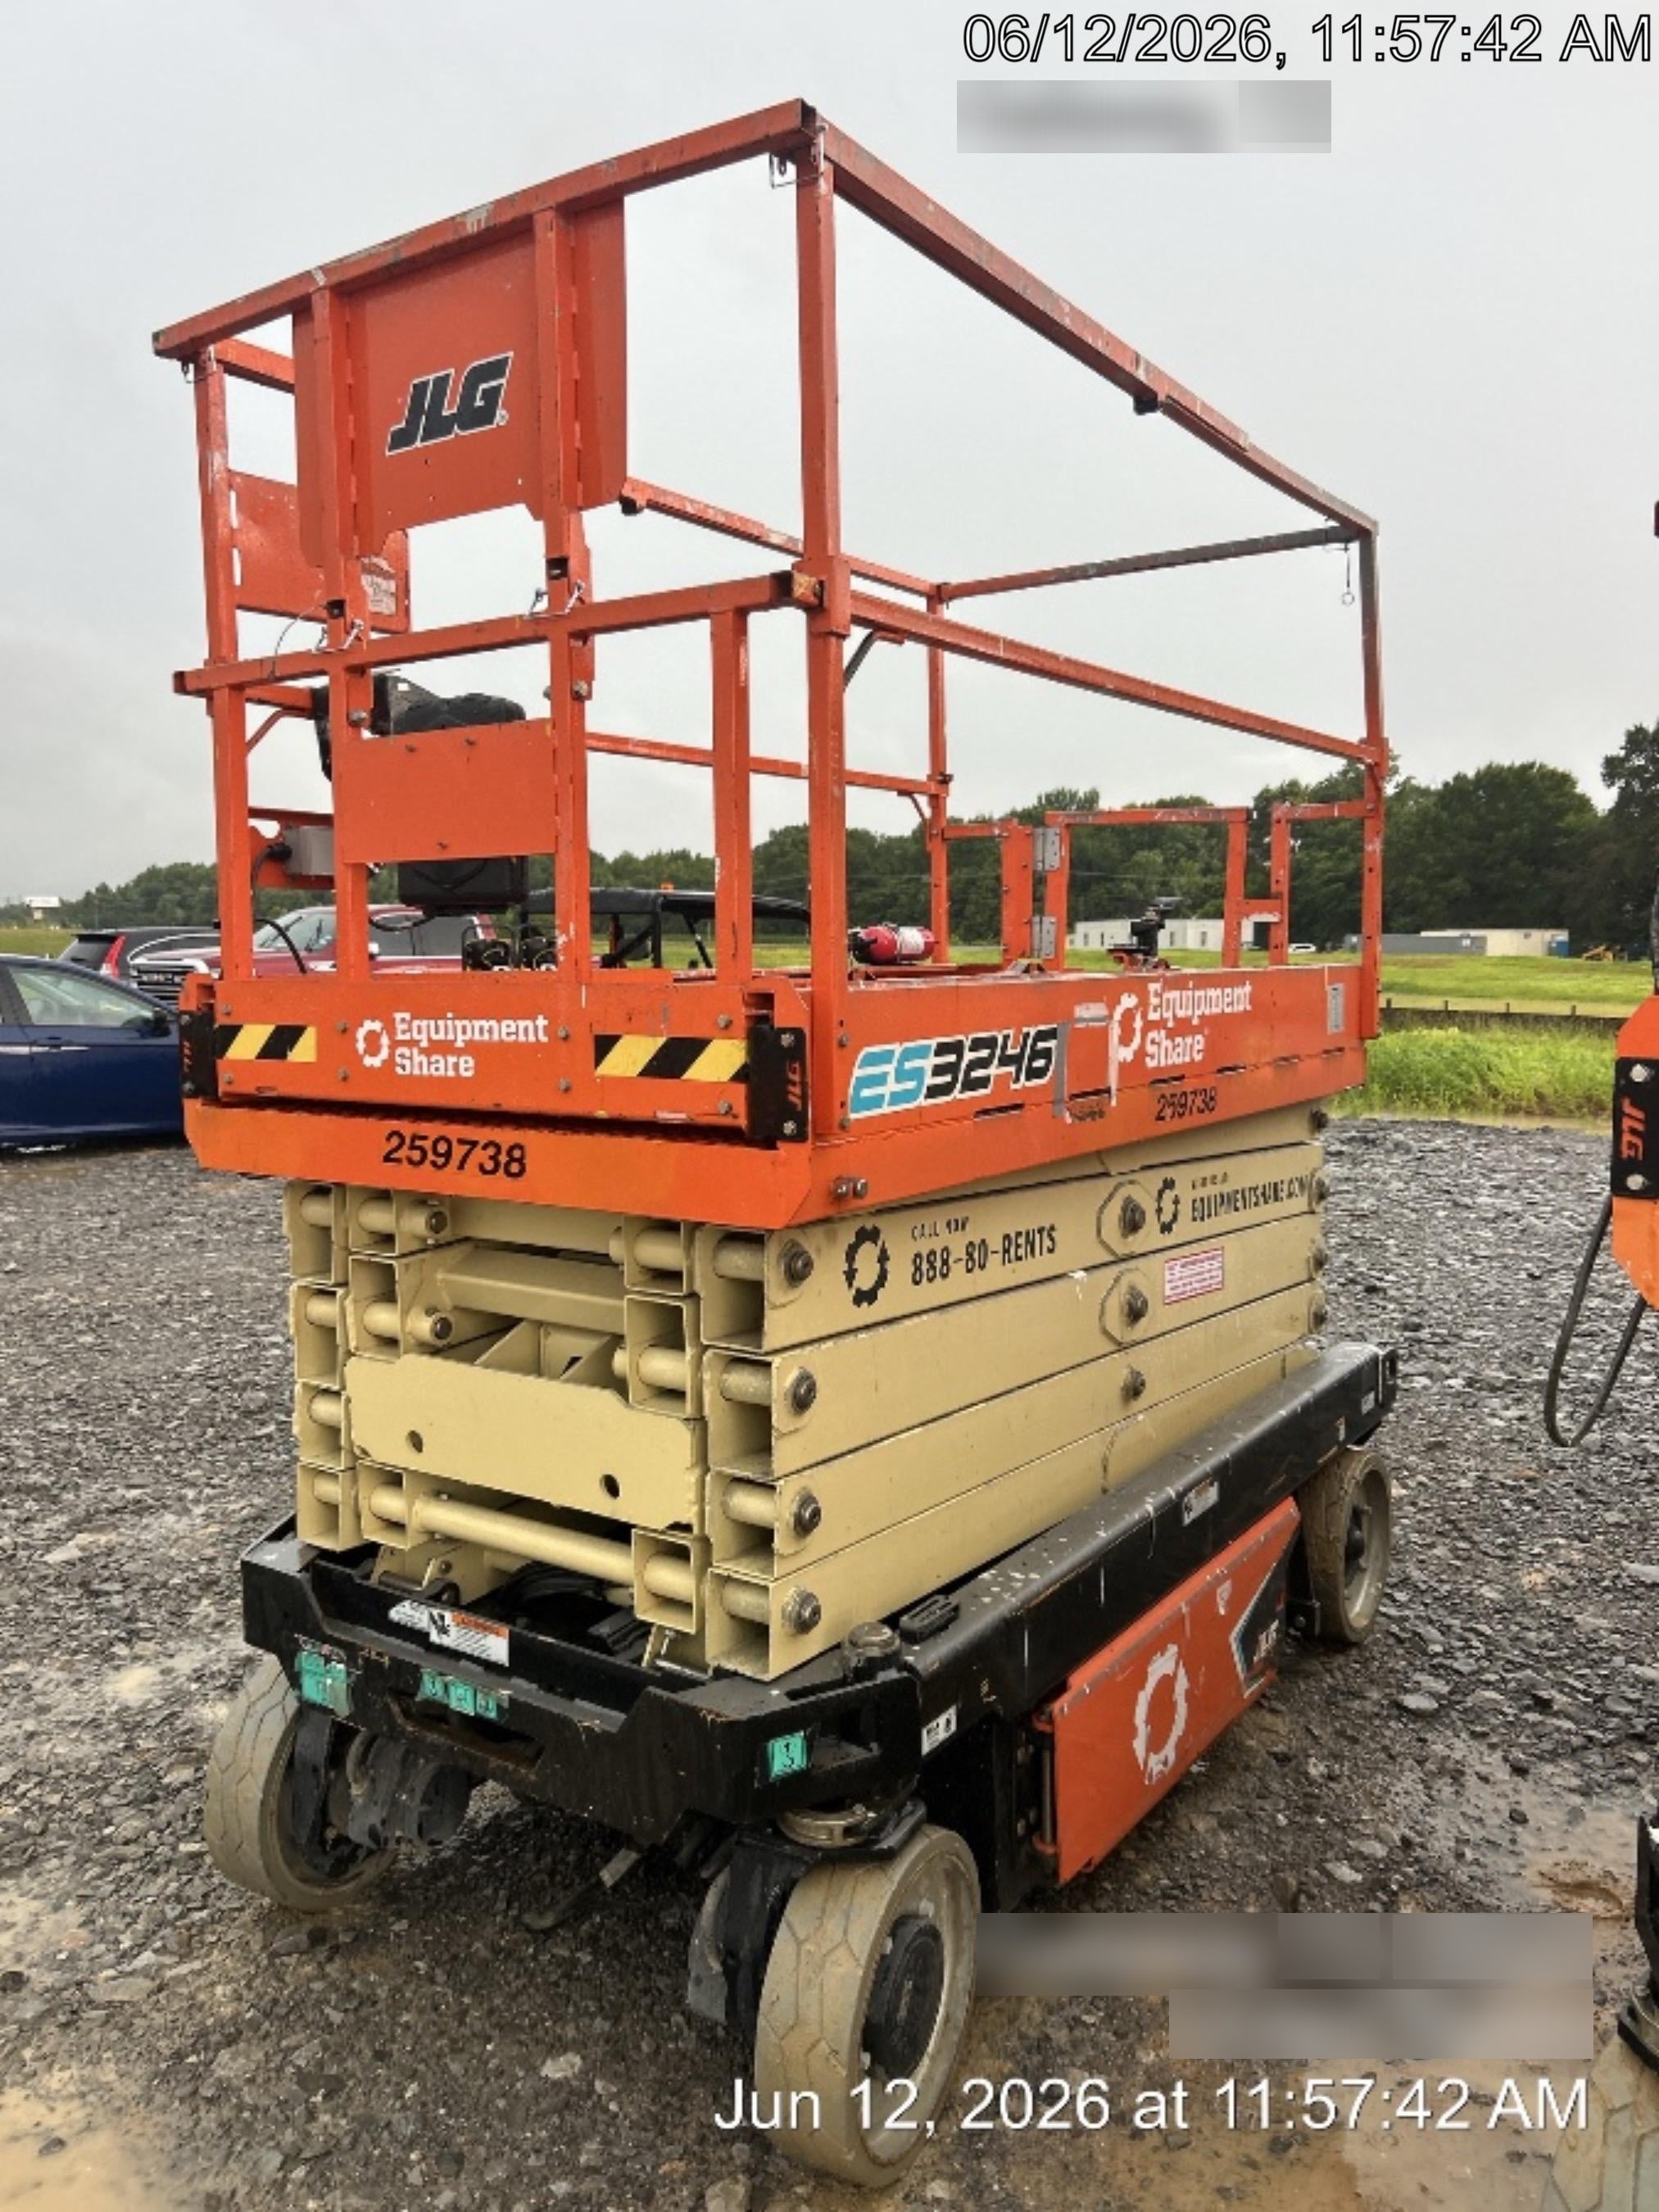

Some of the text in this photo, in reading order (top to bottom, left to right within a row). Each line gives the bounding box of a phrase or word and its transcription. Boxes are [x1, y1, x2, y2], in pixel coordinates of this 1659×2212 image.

[385, 351, 514, 456] JLG
[1147, 980, 1253, 1027] Equipment
[392, 1012, 549, 1048] Equipment
[1145, 1029, 1206, 1068] Share
[394, 1046, 475, 1078] Share
[846, 1024, 1058, 1119] ES3246
[1154, 1087, 1218, 1122] 259738
[1620, 1096, 1646, 1161] JLG
[382, 1130, 527, 1179] 259738
[911, 1223, 1057, 1286] 888-80-RENTS
